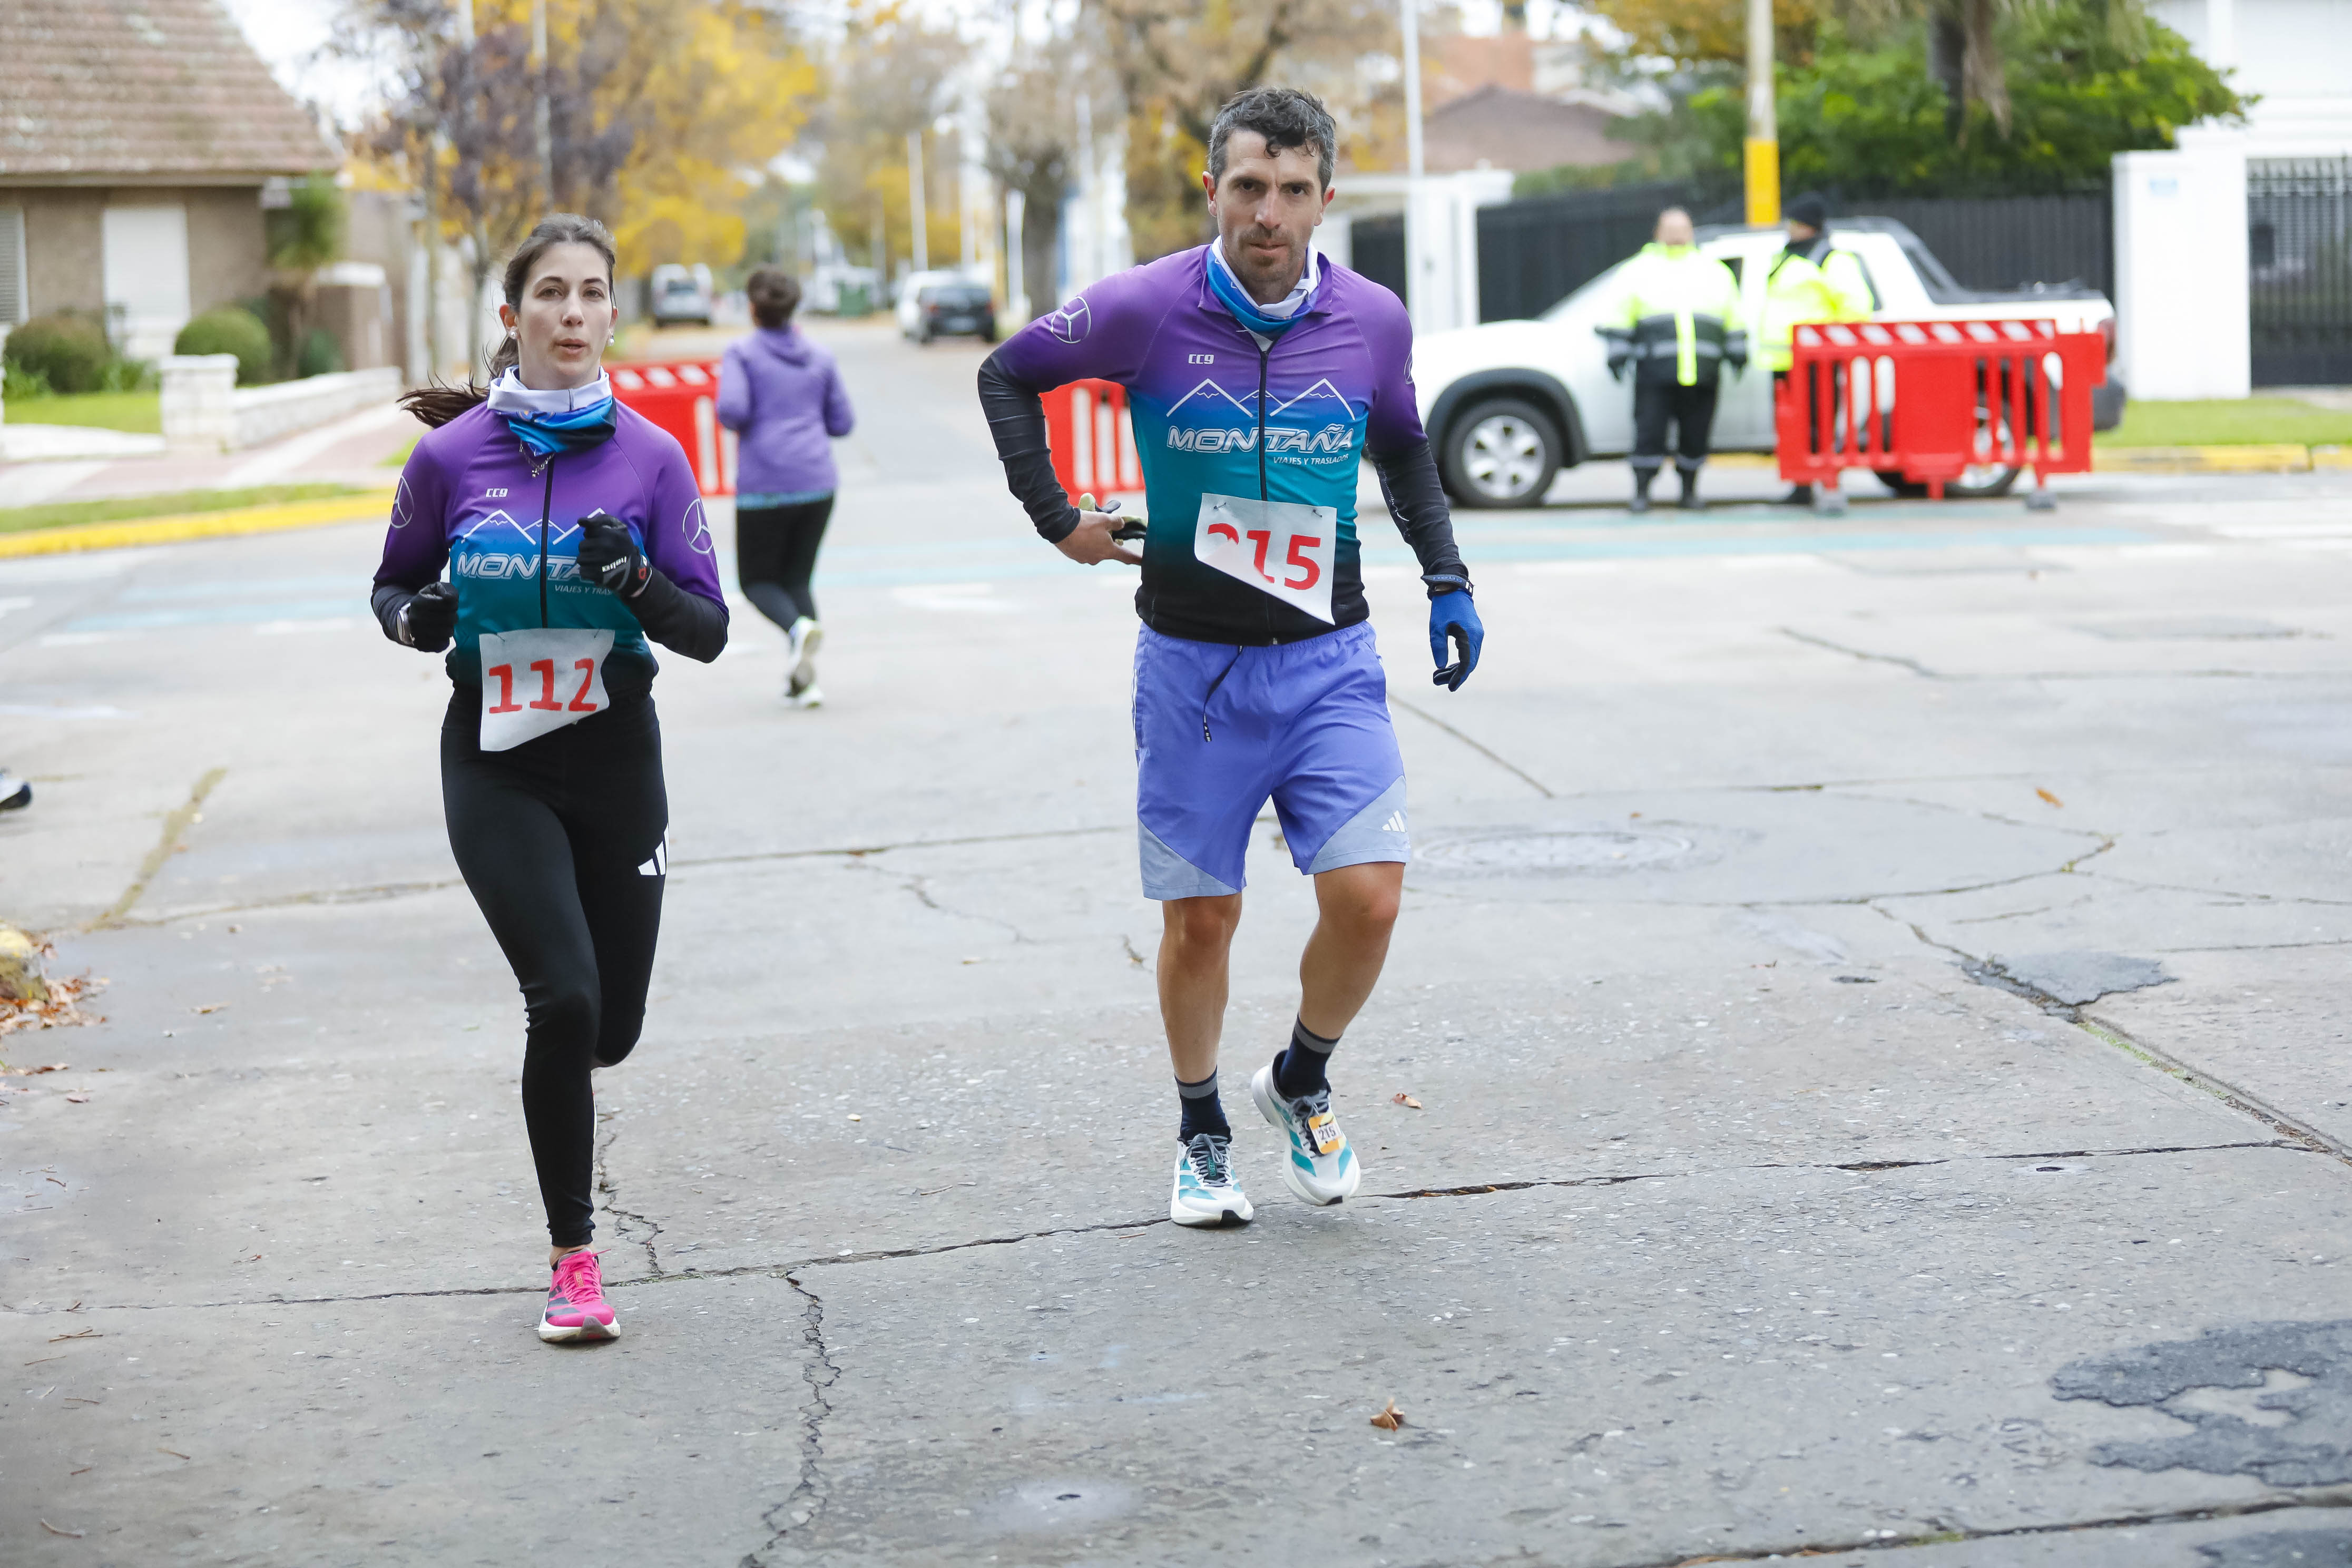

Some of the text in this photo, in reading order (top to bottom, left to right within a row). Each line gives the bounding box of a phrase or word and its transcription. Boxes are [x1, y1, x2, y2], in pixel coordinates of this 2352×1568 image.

[1167, 423, 1354, 454] MONTAÑA
[1273, 456, 1302, 465] VIAJES
[1310, 453, 1349, 465] TRASLADOS
[555, 584, 582, 593] VIAJES
[488, 658, 598, 714] 112
[1318, 1126, 1336, 1140] 215
